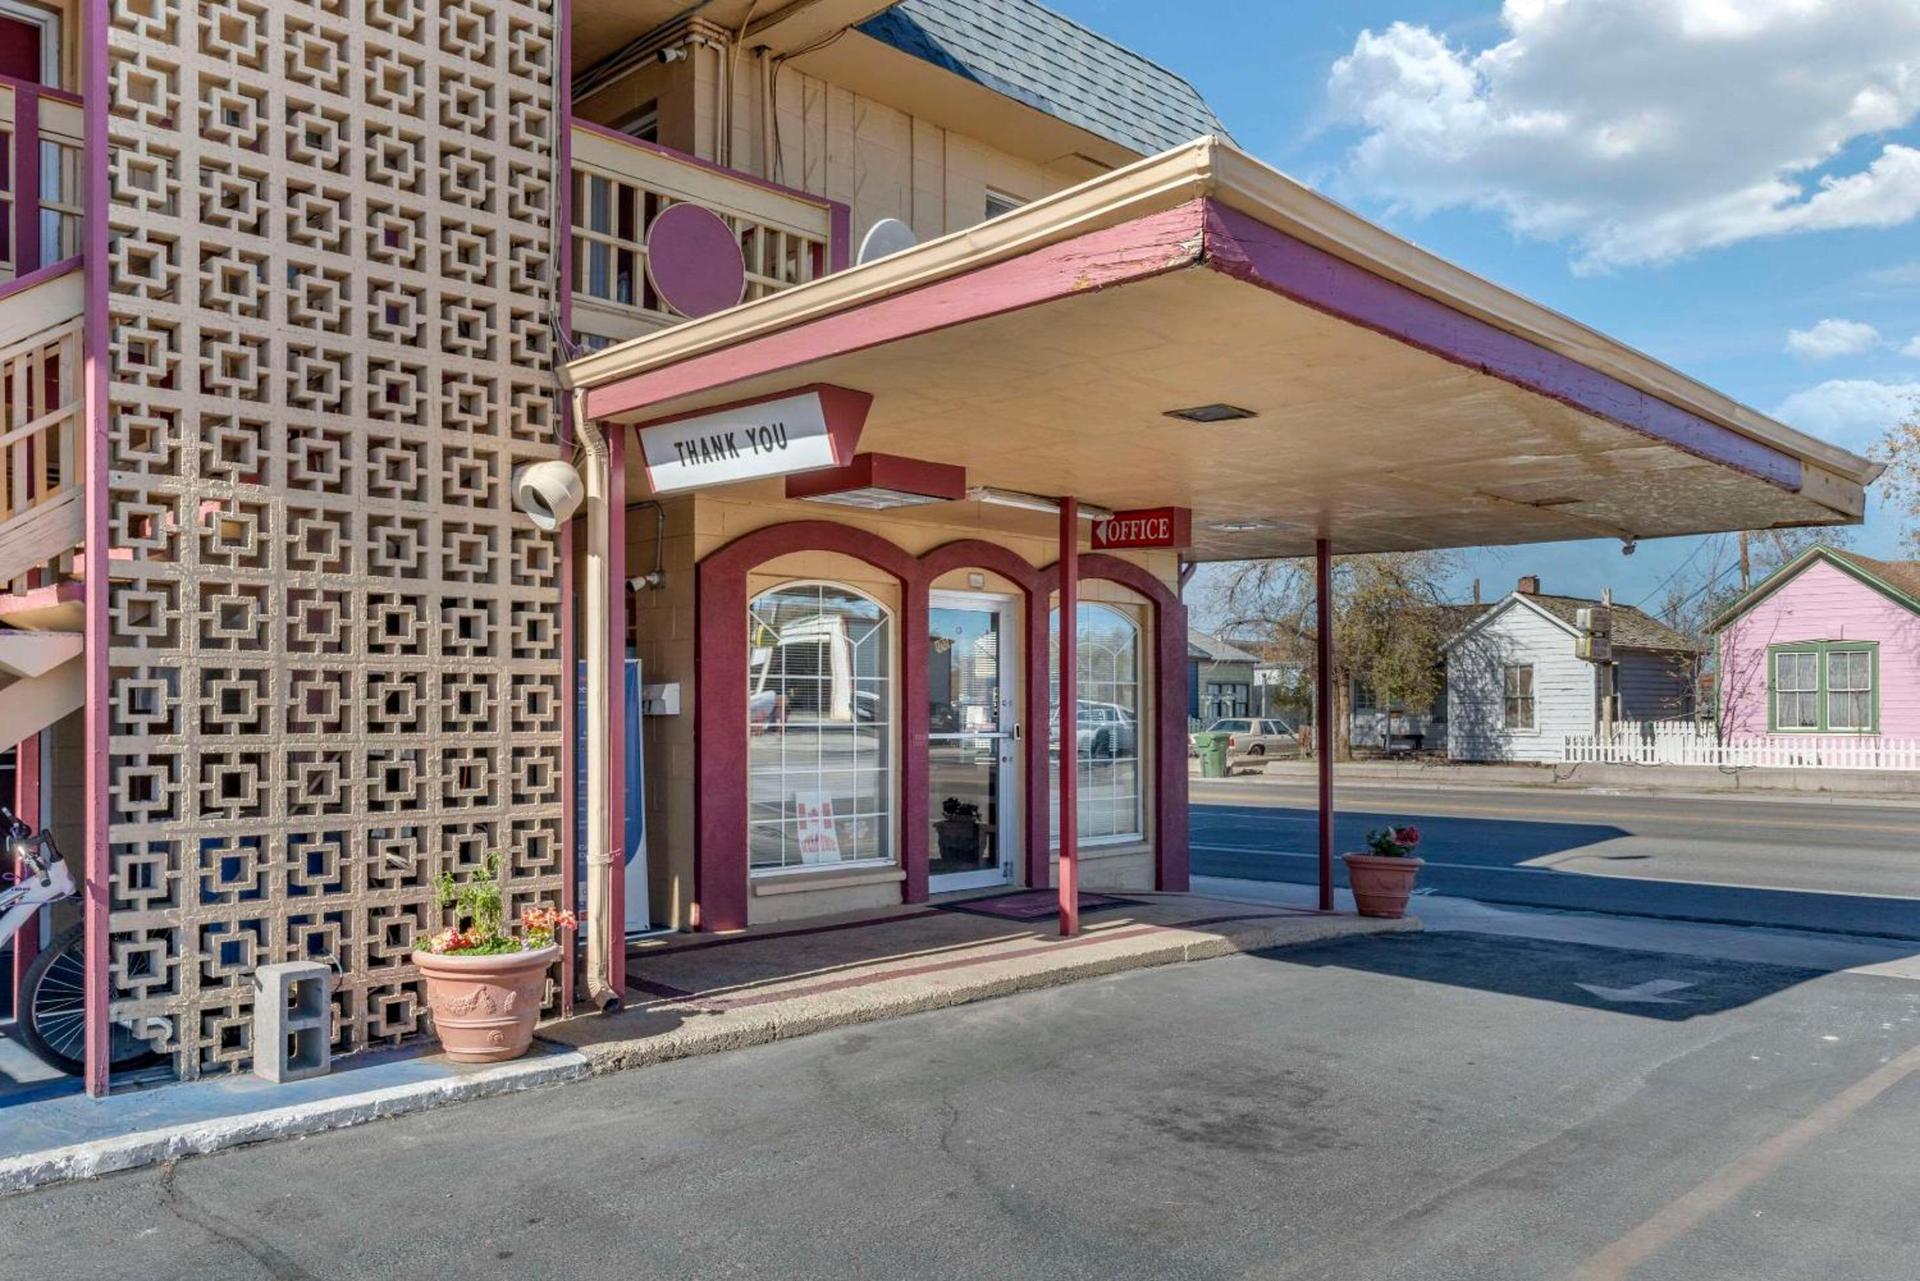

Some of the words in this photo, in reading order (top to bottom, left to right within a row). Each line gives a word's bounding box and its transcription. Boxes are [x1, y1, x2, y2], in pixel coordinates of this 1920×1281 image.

[674, 432, 740, 467] THANK
[745, 422, 788, 455] YOU
[1108, 518, 1169, 541] OFFICE
